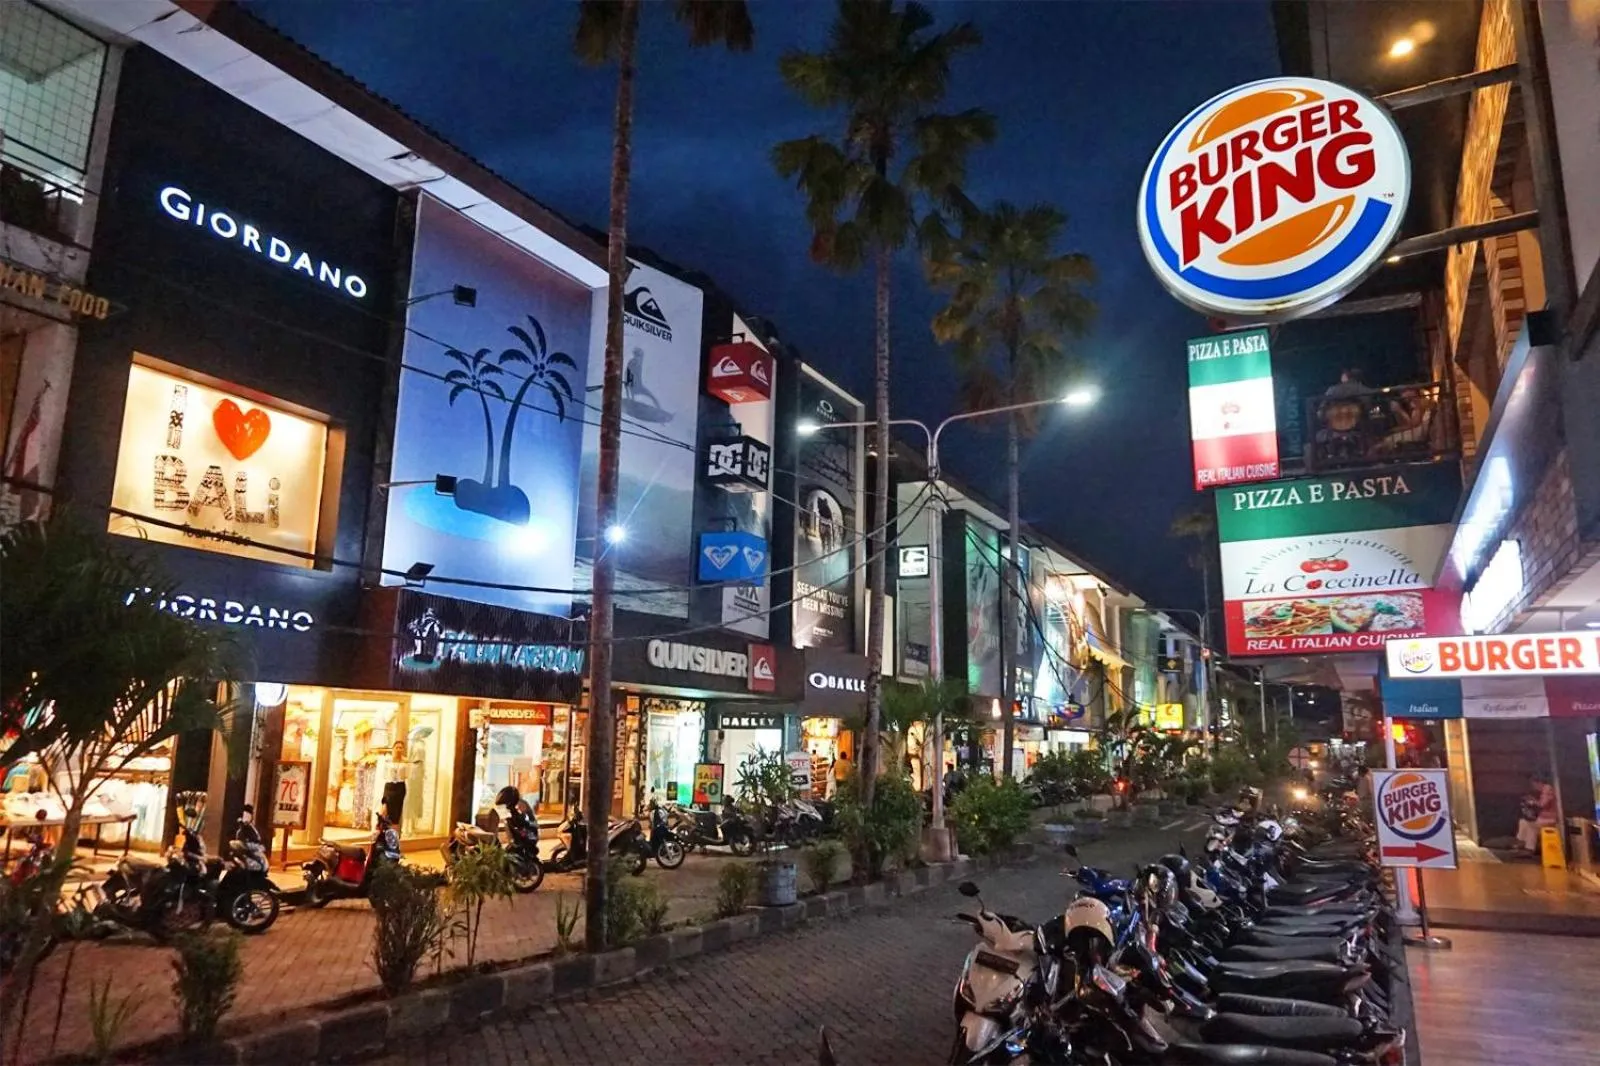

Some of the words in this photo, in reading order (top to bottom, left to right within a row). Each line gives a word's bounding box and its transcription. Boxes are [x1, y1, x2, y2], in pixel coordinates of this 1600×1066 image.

[1169, 99, 1363, 211] BURGER
[1180, 131, 1376, 266] KING
[160, 186, 368, 298] GIORDANO
[1188, 341, 1221, 362] PIZZA
[1222, 340, 1231, 357] E
[1232, 334, 1269, 356] PASTA
[1197, 468, 1217, 483] REAL
[1218, 465, 1245, 481] ITALIAN
[1246, 462, 1277, 479] CUISINE
[1232, 487, 1303, 511] PIZZA
[1308, 484, 1325, 504] E
[1331, 475, 1411, 501] PASTA
[1244, 578, 1275, 595] La
[126, 586, 314, 631] IORDANO
[501, 641, 585, 675] LAGOON
[647, 639, 749, 678] QUIKSILVER
[1247, 638, 1288, 651] REAL
[1291, 636, 1353, 650] ITALIAN
[1438, 637, 1585, 673] BURGER
[828, 675, 866, 693] OAKLE
[722, 717, 775, 727] OAKLEY
[1408, 703, 1439, 713] Italian
[1384, 782, 1437, 807] BURGER
[1388, 794, 1441, 825] KING
